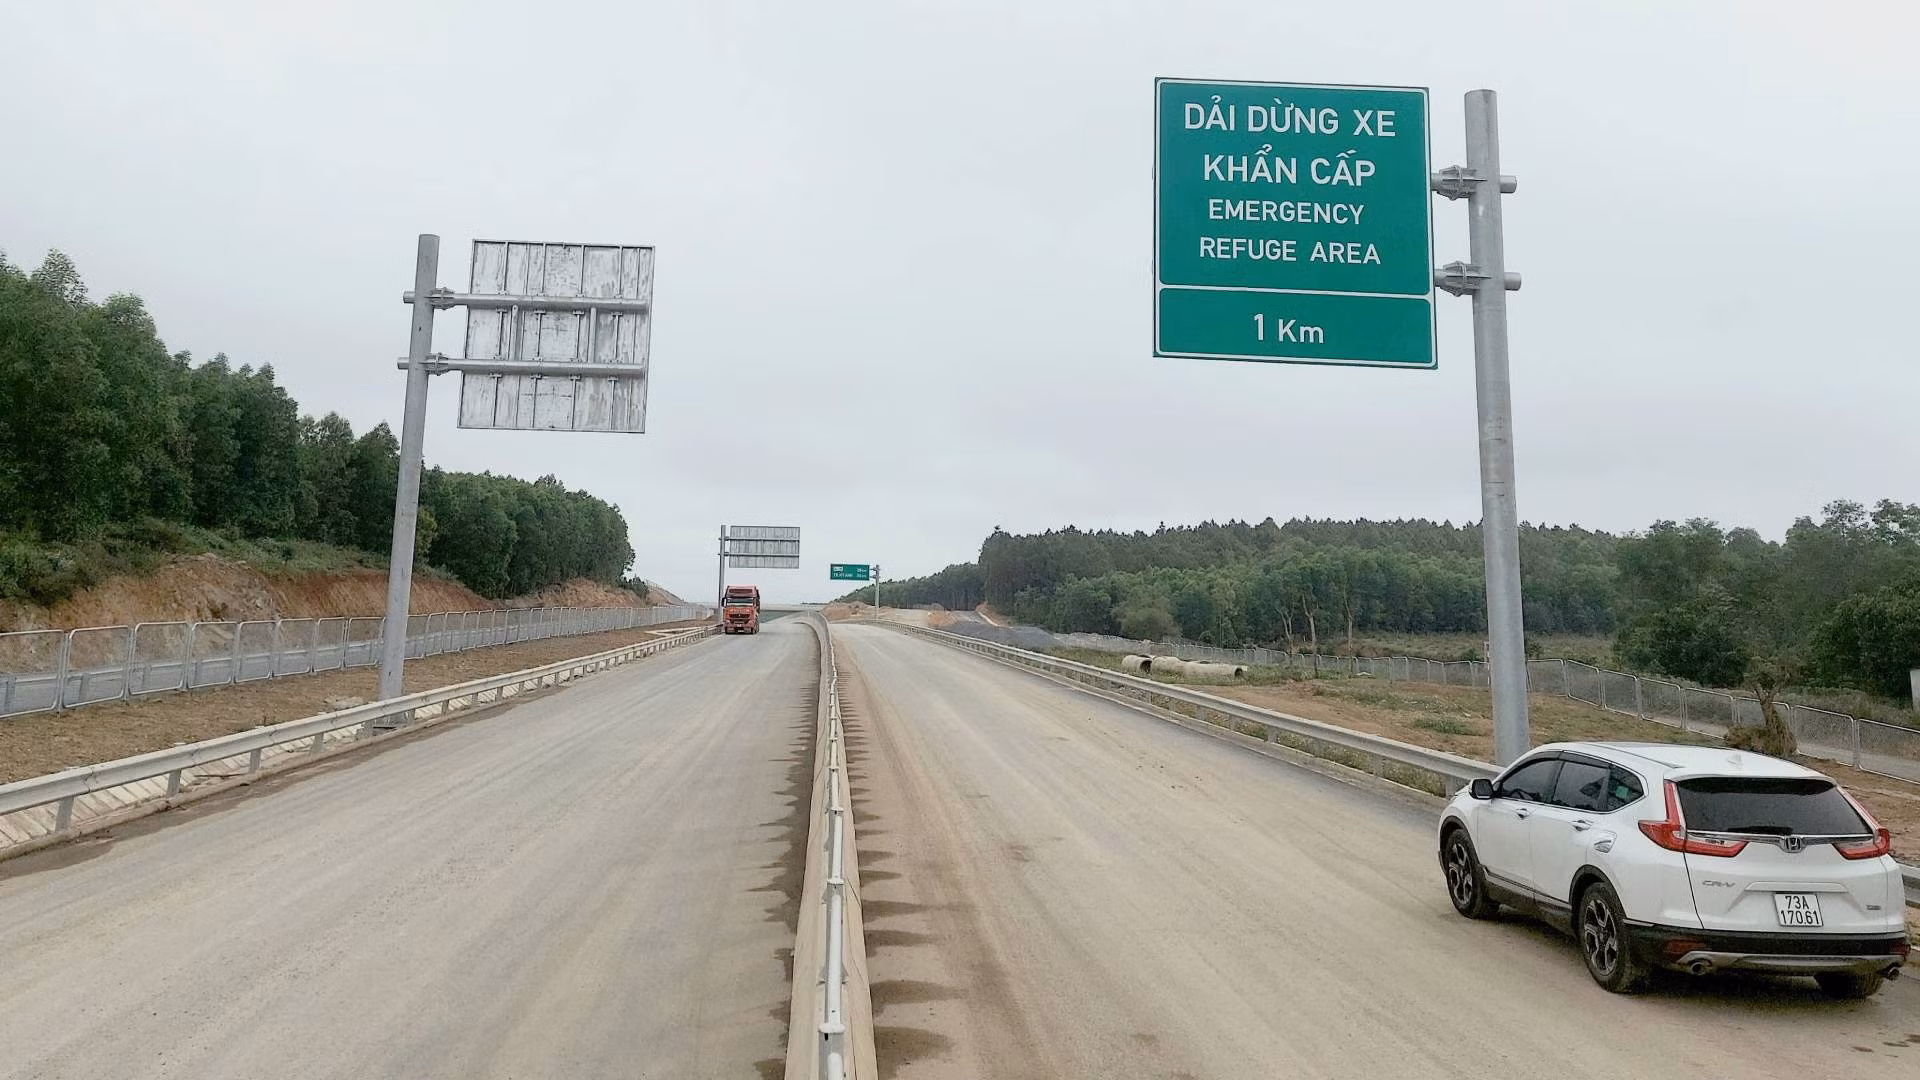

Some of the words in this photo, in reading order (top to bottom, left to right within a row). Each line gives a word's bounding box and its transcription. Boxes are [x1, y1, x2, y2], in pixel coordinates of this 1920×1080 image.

[1184, 95, 1236, 131] DẢI
[1247, 97, 1339, 135] DỪNG
[1353, 109, 1396, 137] XE
[1203, 144, 1298, 184] KHẨN
[1310, 149, 1376, 187] CẤP
[1208, 199, 1364, 225] EMERGENCY
[1199, 237, 1297, 262] REFUGE
[1309, 241, 1381, 265] AREA
[1254, 313, 1264, 341] 1
[1278, 319, 1324, 344] Km
[1785, 895, 1810, 910] 73A
[1780, 910, 1819, 925] 170.61
